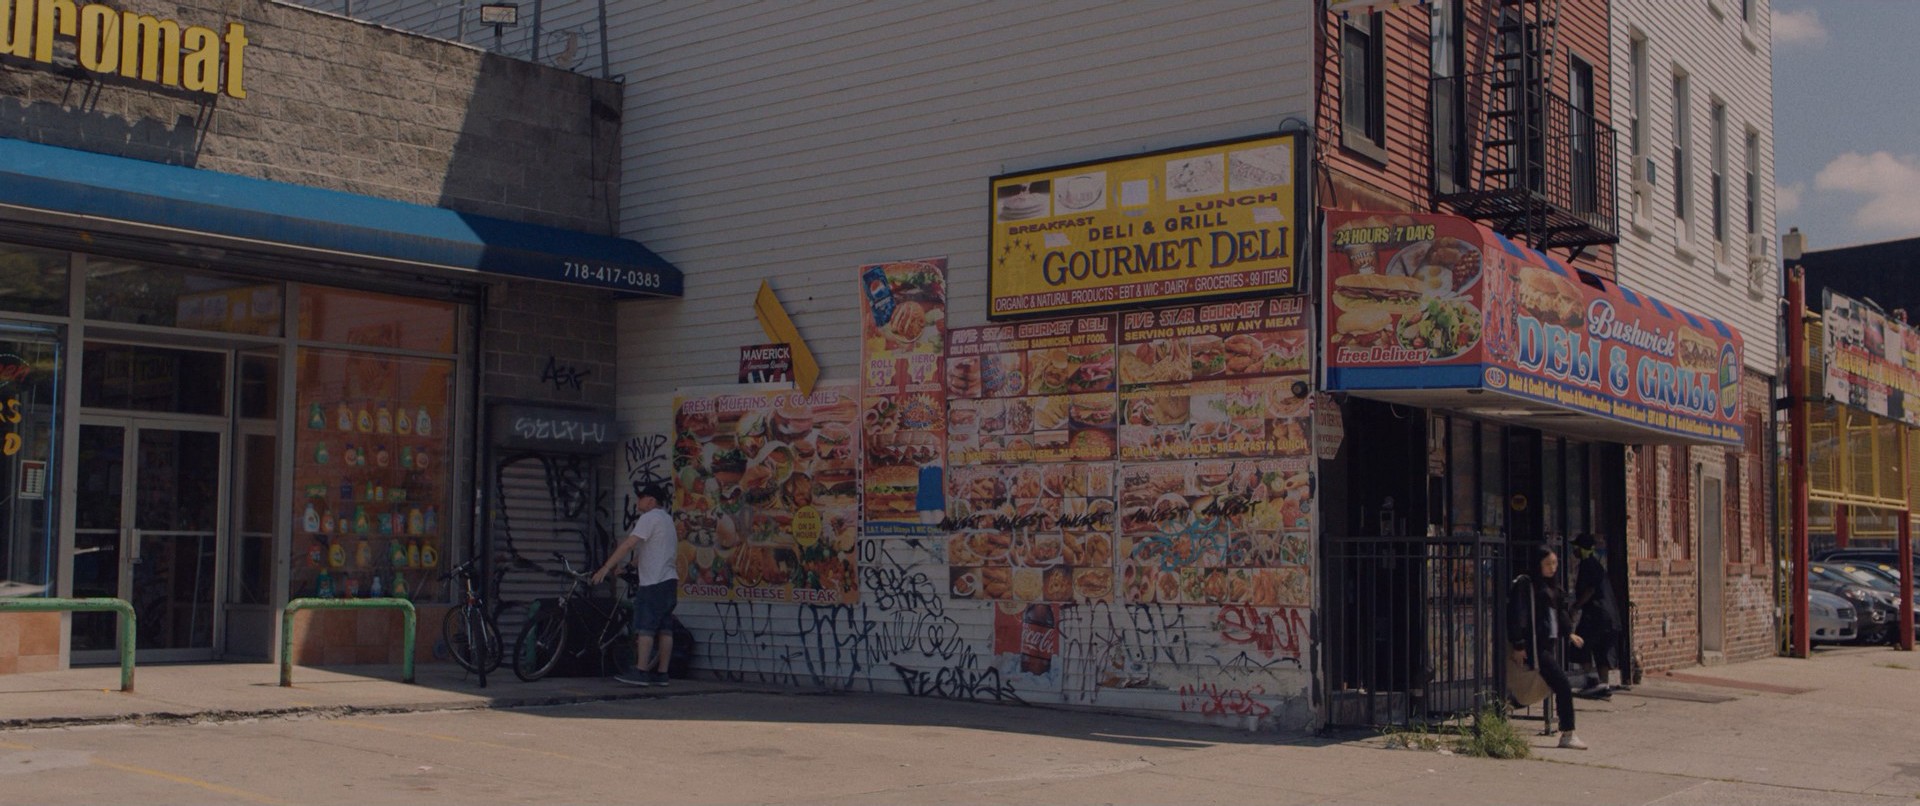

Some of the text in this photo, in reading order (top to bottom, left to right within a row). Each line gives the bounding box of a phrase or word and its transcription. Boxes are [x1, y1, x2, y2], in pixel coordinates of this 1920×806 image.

[1178, 193, 1277, 213] LUNCH
[1008, 216, 1095, 235] BREAKFAST
[1089, 212, 1228, 242] DELI & GRILL
[1336, 230, 1350, 245] 24
[1351, 226, 1390, 244] HOURS
[1406, 224, 1436, 241] DAYS
[1042, 226, 1290, 286] GOURMET DELI
[564, 262, 661, 288] 718-417-0383
[995, 298, 1029, 312] ORGANIC
[1036, 292, 1070, 308] NATURAL
[1071, 287, 1114, 304] PRODUCTS
[1119, 285, 1134, 299] EBT
[1143, 282, 1159, 296] WIC
[1164, 279, 1189, 295] DAIRY
[1194, 273, 1244, 291] GROCERIES
[1261, 269, 1288, 285] ITEMS
[1159, 307, 1195, 326] STAR
[1200, 300, 1265, 322] GOURMET
[1269, 297, 1303, 316] DELI
[1018, 320, 1073, 338] GOURMET
[1078, 317, 1109, 333] DELI
[1124, 329, 1174, 341] SERVING
[1177, 323, 1218, 336] WRAPS
[1237, 319, 1261, 331] ANY
[1265, 316, 1300, 328] MEAT
[1587, 298, 1676, 358] Bushwick
[742, 348, 791, 361] MAVERICK
[870, 359, 893, 369] ROLL
[911, 353, 936, 363] HERO
[1337, 345, 1432, 364] Free Delivery
[1516, 312, 1602, 390] DELI
[1608, 345, 1629, 396] &
[1636, 355, 1717, 419] GRILL
[682, 391, 839, 414] FRESH MUFFINS & COOKIES
[683, 585, 836, 601] CASINO CHEESE STEAK
